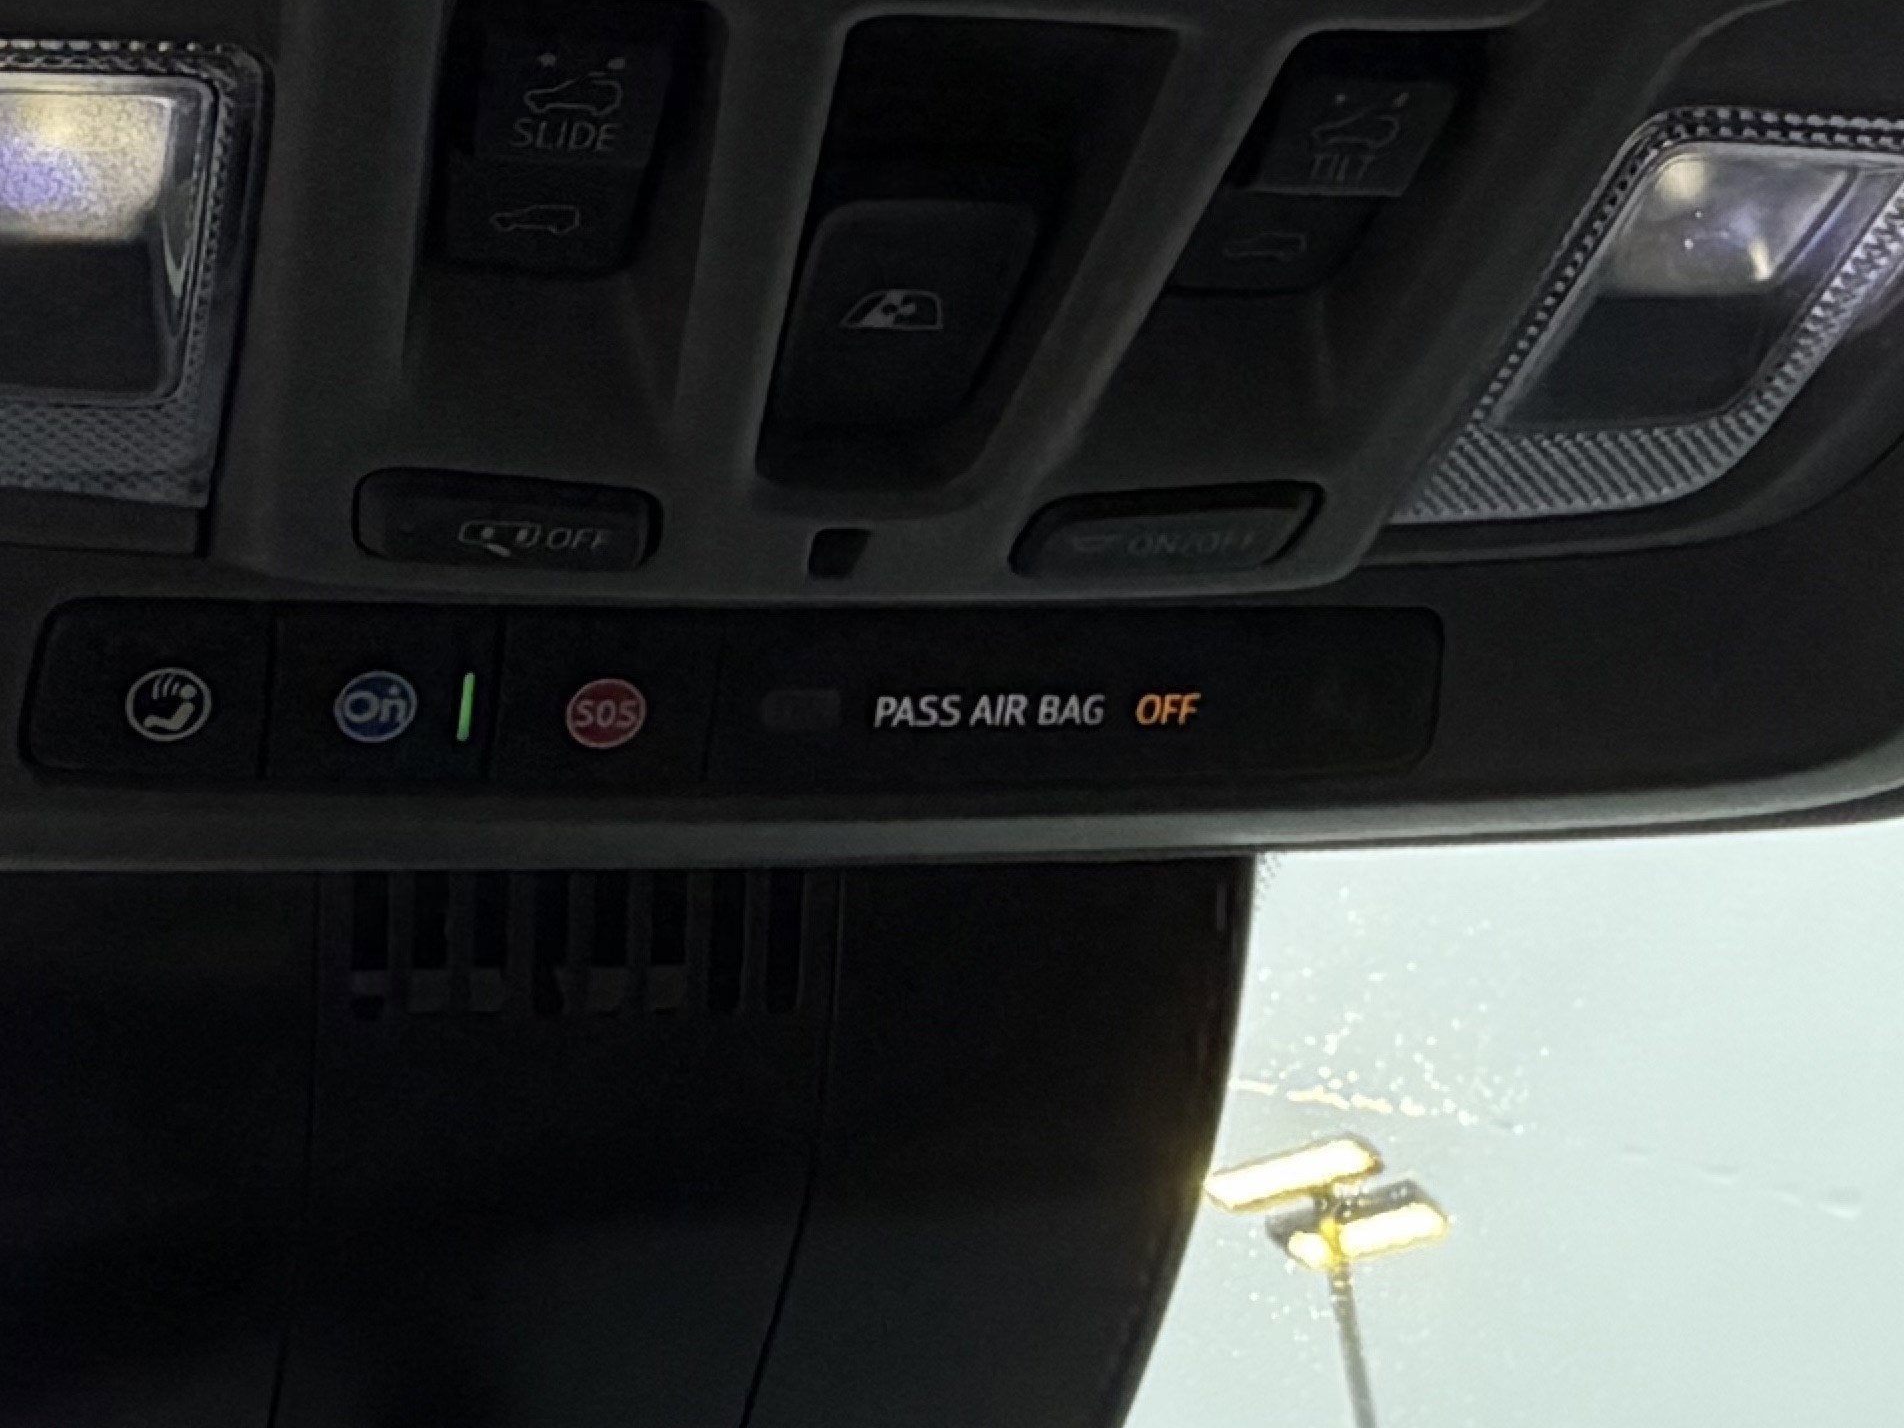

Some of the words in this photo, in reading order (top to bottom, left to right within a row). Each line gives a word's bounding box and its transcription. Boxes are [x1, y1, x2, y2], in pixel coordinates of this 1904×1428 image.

[512, 117, 622, 153] SLIDE
[545, 526, 612, 552] OFF
[574, 699, 639, 730] SOS
[872, 694, 963, 728] PASS
[969, 694, 1028, 727] AIR
[1037, 694, 1107, 726] BAG
[1135, 691, 1203, 726] OFF
